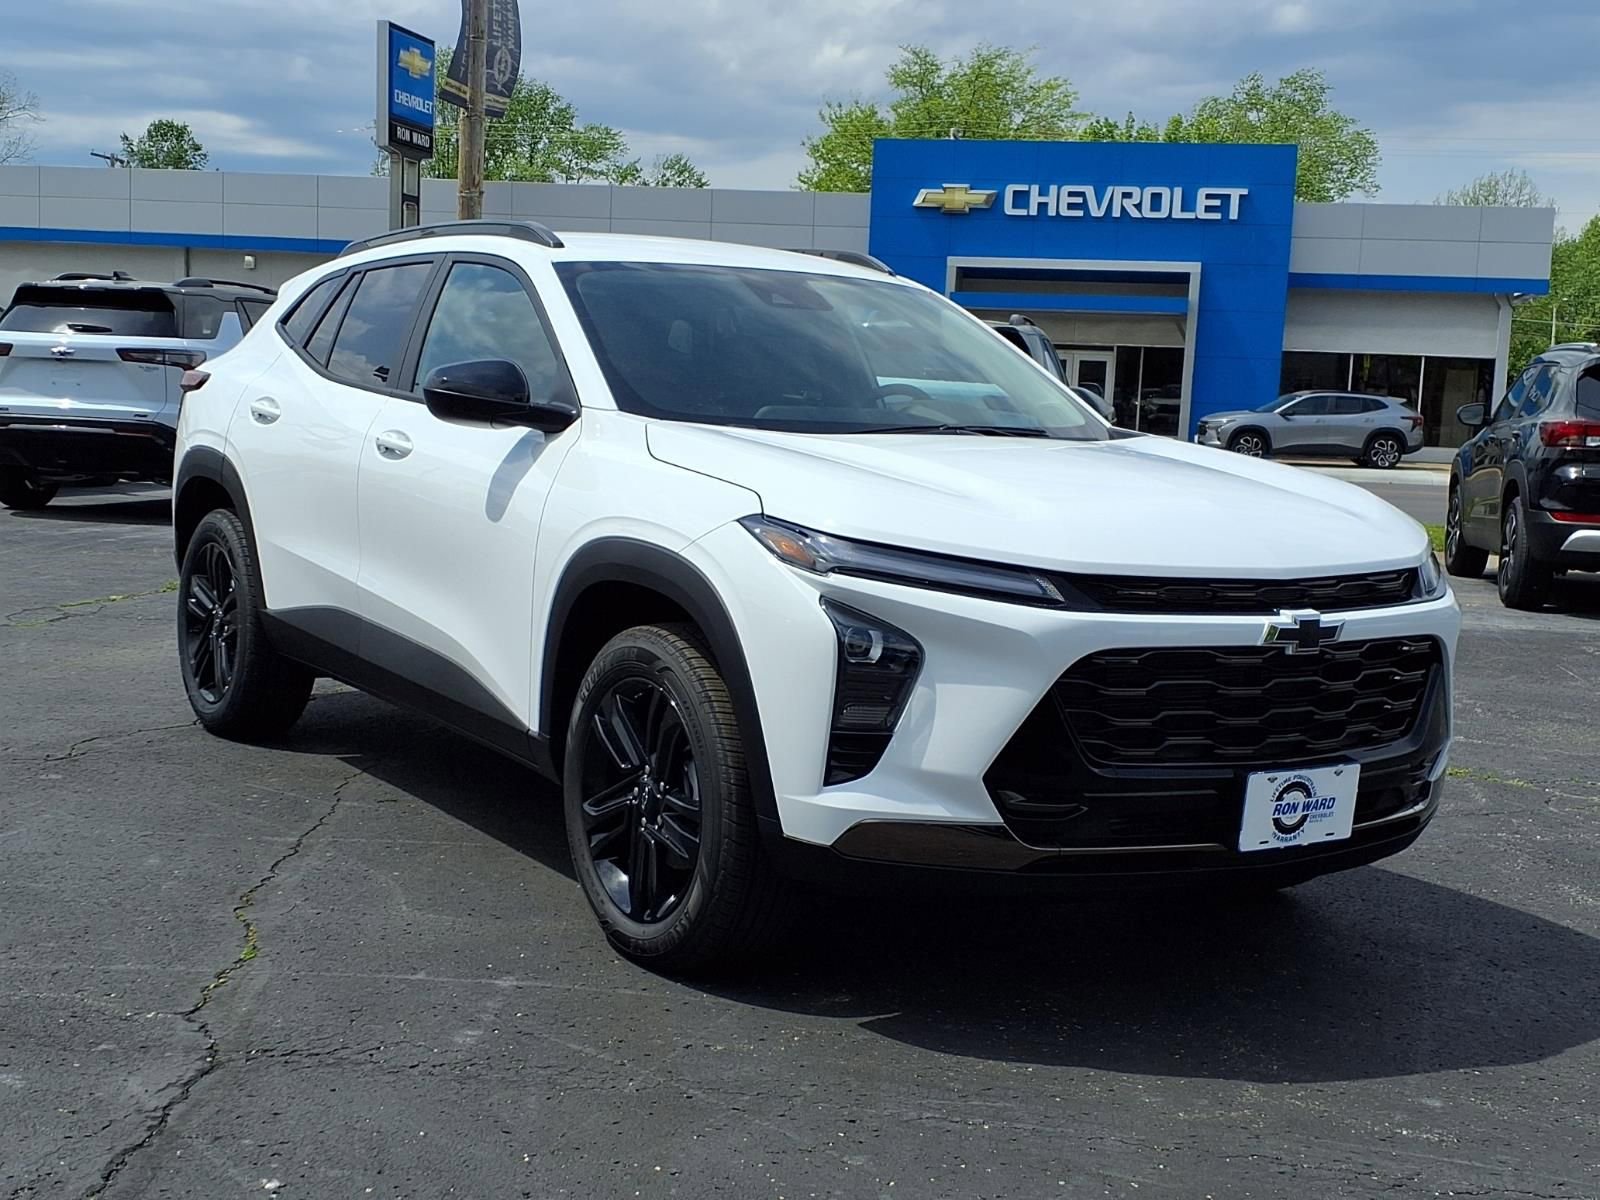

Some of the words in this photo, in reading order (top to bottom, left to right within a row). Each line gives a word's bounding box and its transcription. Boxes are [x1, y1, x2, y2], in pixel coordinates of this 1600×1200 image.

[394, 89, 433, 115] CHEVROLET
[397, 127, 410, 142] RON
[412, 131, 430, 147] WARD
[1004, 184, 1248, 220] CHEVROLET
[1272, 801, 1300, 816] RON
[1301, 797, 1336, 812] WARD
[1272, 828, 1304, 843] WARRANTY
